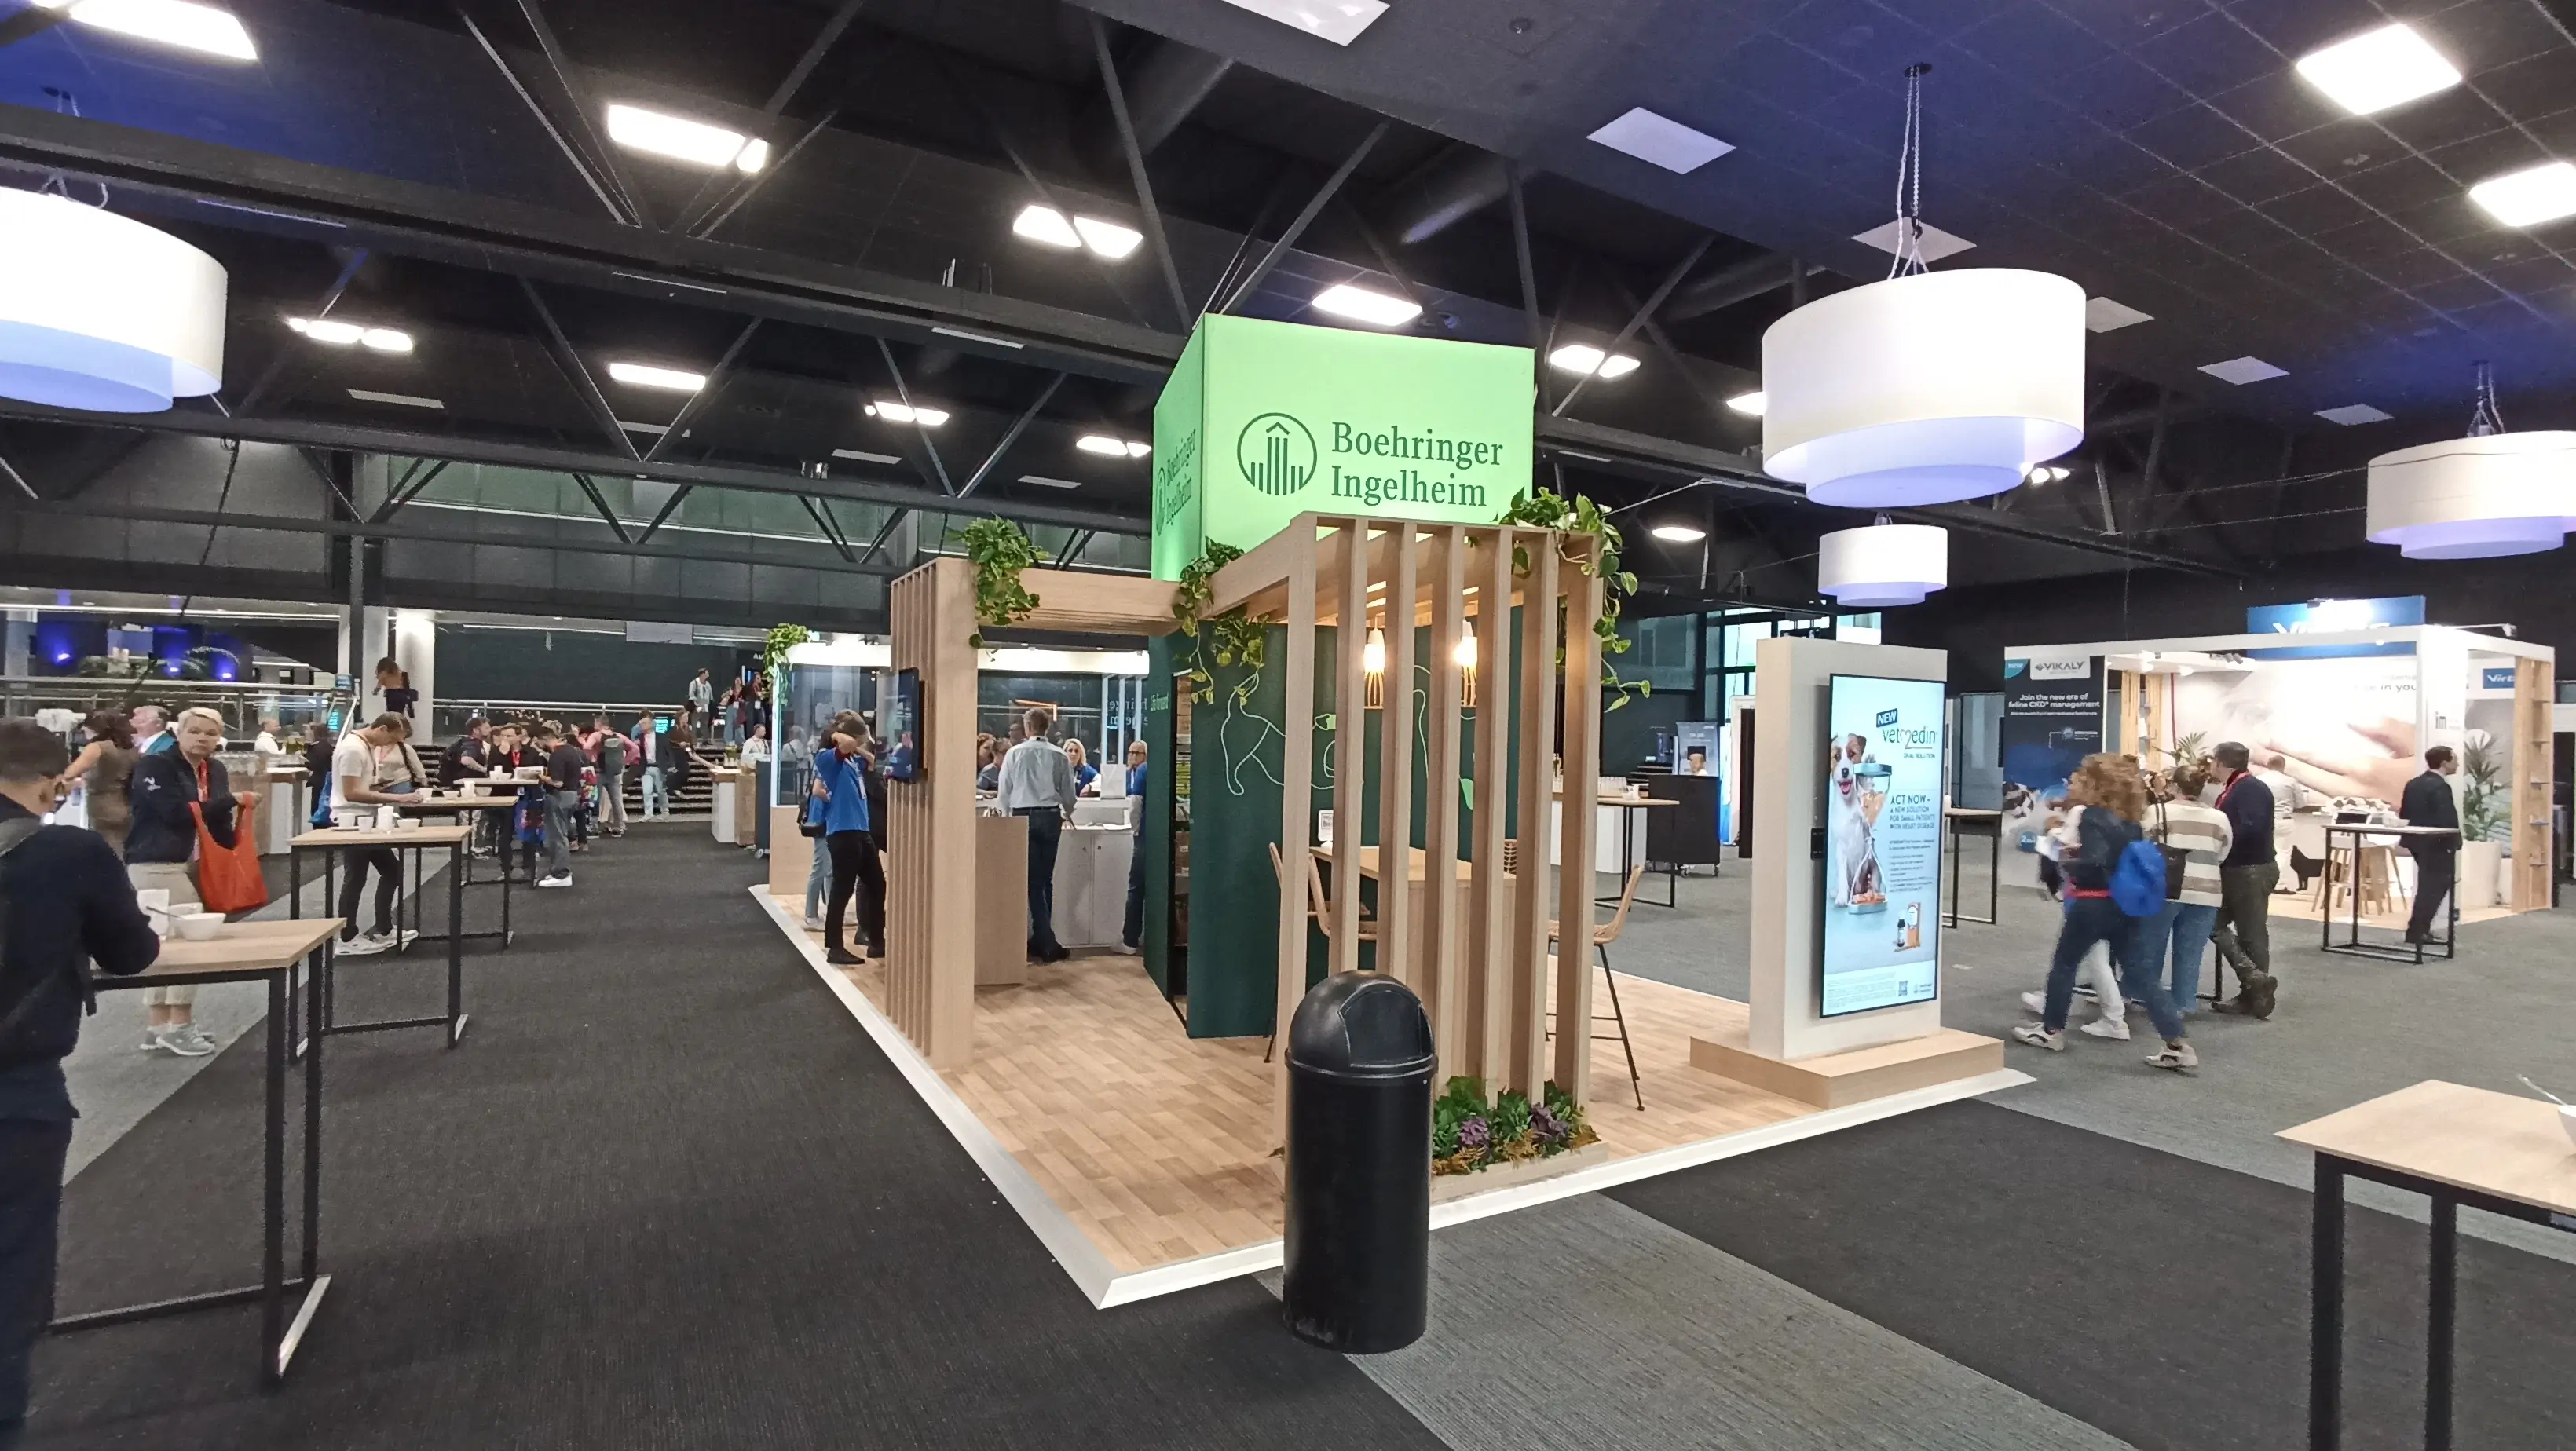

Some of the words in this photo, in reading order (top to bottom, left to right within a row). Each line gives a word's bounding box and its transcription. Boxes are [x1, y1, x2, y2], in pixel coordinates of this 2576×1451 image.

[1331, 421, 1503, 470] Boehringer
[1331, 465, 1487, 506] Ingelheim
[2044, 661, 2084, 671] VIKALY
[2050, 700, 2100, 709] management
[1878, 711, 1897, 726] NEW
[1890, 795, 1905, 804] ACT
[1908, 795, 1926, 804] NOW
